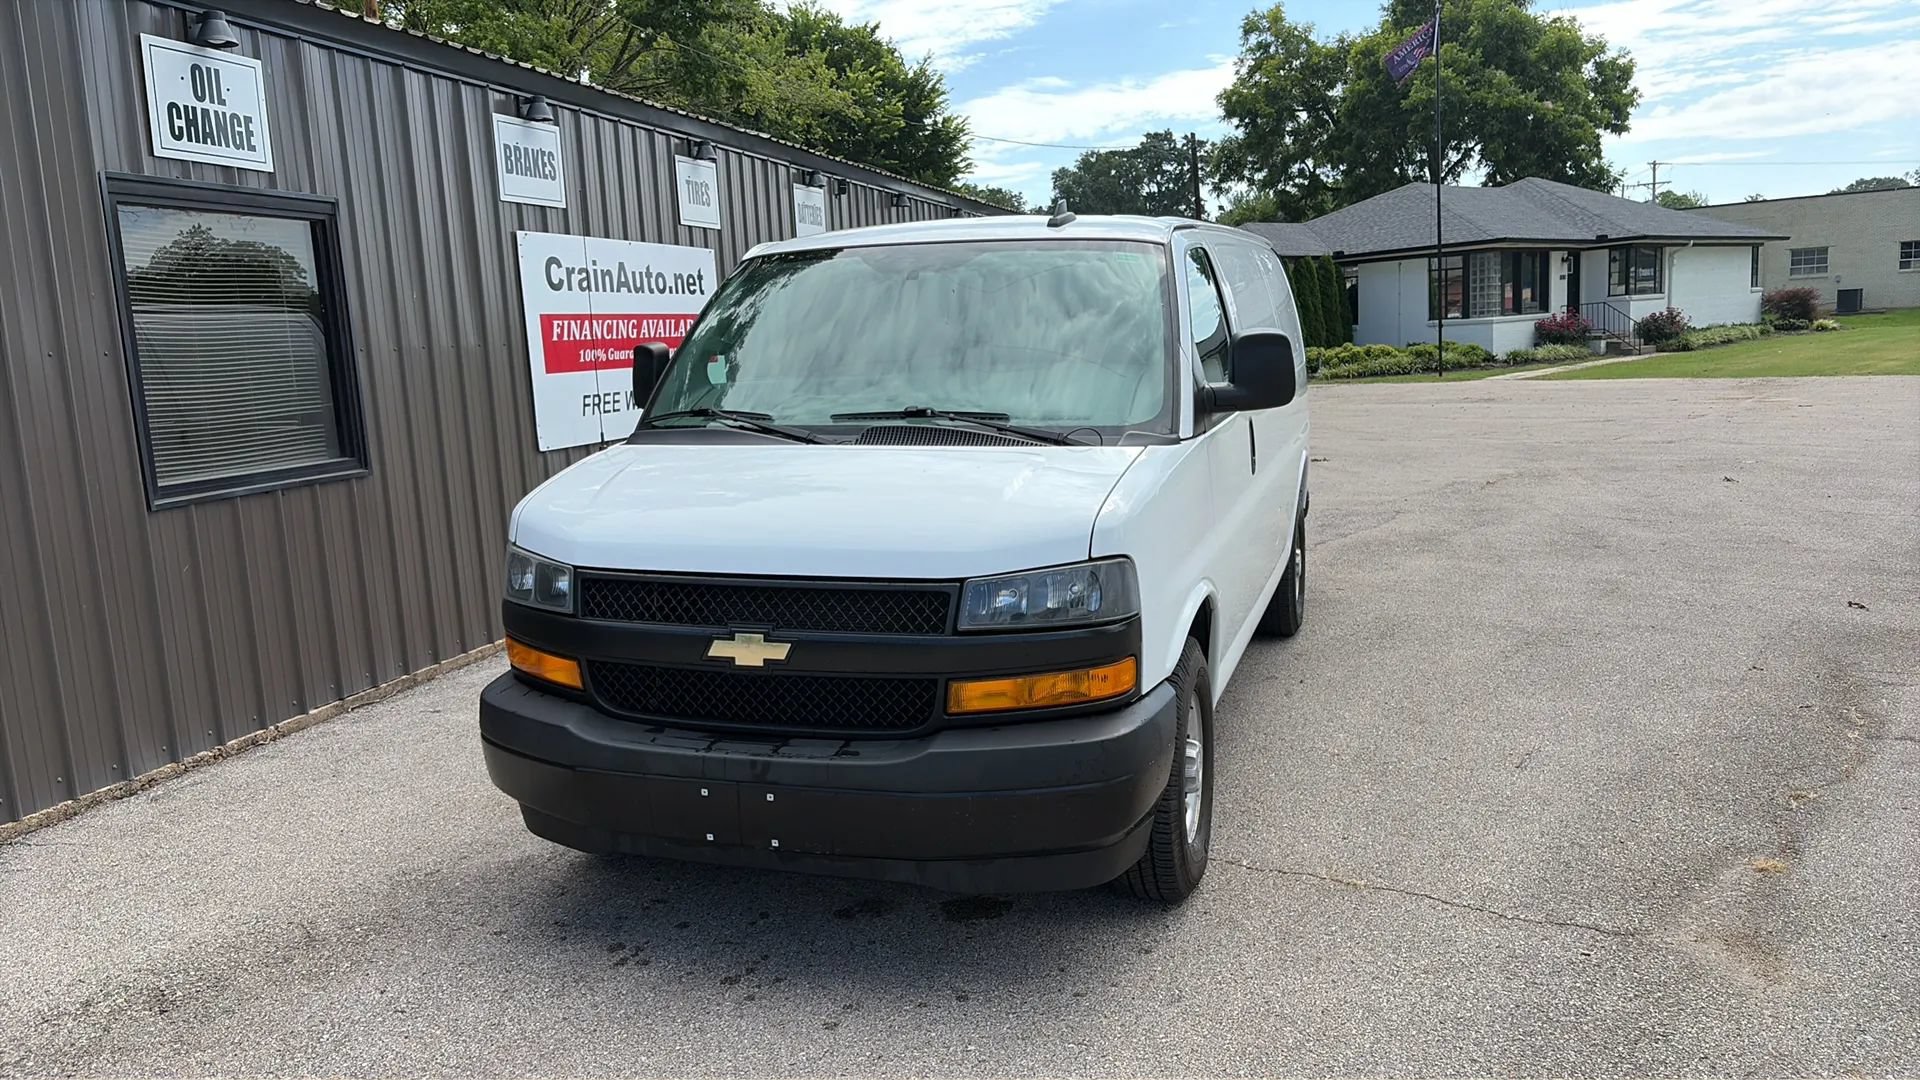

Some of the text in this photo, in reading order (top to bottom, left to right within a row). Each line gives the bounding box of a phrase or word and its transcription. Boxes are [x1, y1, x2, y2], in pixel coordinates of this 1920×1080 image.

[190, 63, 227, 107] OIL
[166, 101, 257, 152] CHANGE
[503, 143, 557, 182] BRAKES
[685, 178, 711, 208] TIRES
[544, 256, 705, 296] CrainAuto.net
[552, 319, 637, 341] FINANCING
[579, 347, 634, 362] 100% Guara
[583, 391, 620, 416] FREE
